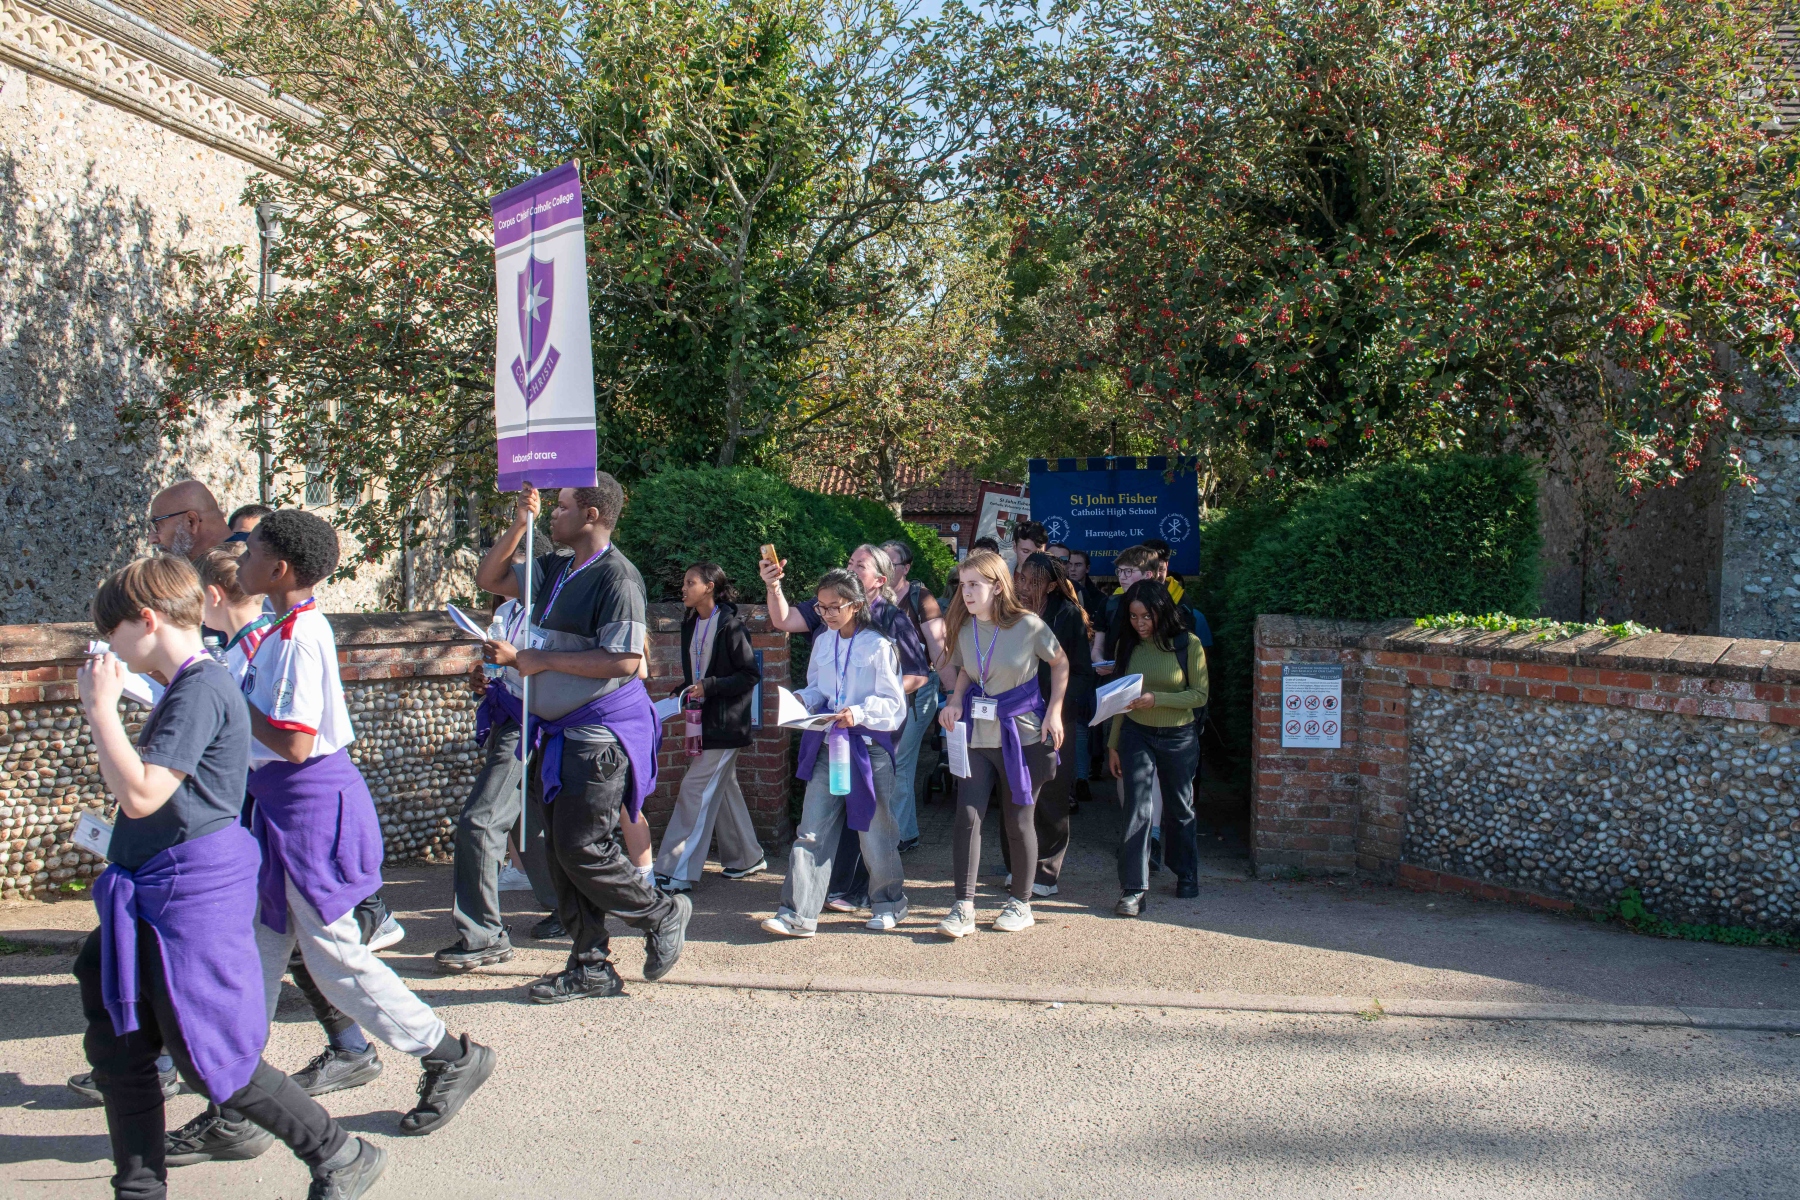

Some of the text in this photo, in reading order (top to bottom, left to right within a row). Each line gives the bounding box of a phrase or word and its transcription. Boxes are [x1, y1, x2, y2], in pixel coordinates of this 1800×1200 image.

[497, 216, 515, 230] Corpus
[529, 200, 551, 216] Catholic
[552, 192, 574, 208] College
[527, 357, 554, 400] CHRISTI
[534, 451, 558, 460] orare
[1070, 492, 1158, 508] St John Fisher
[1071, 506, 1158, 518] Catholic High School
[1084, 528, 1145, 539] Harrogate, UK
[1090, 549, 1119, 557] FISHER
